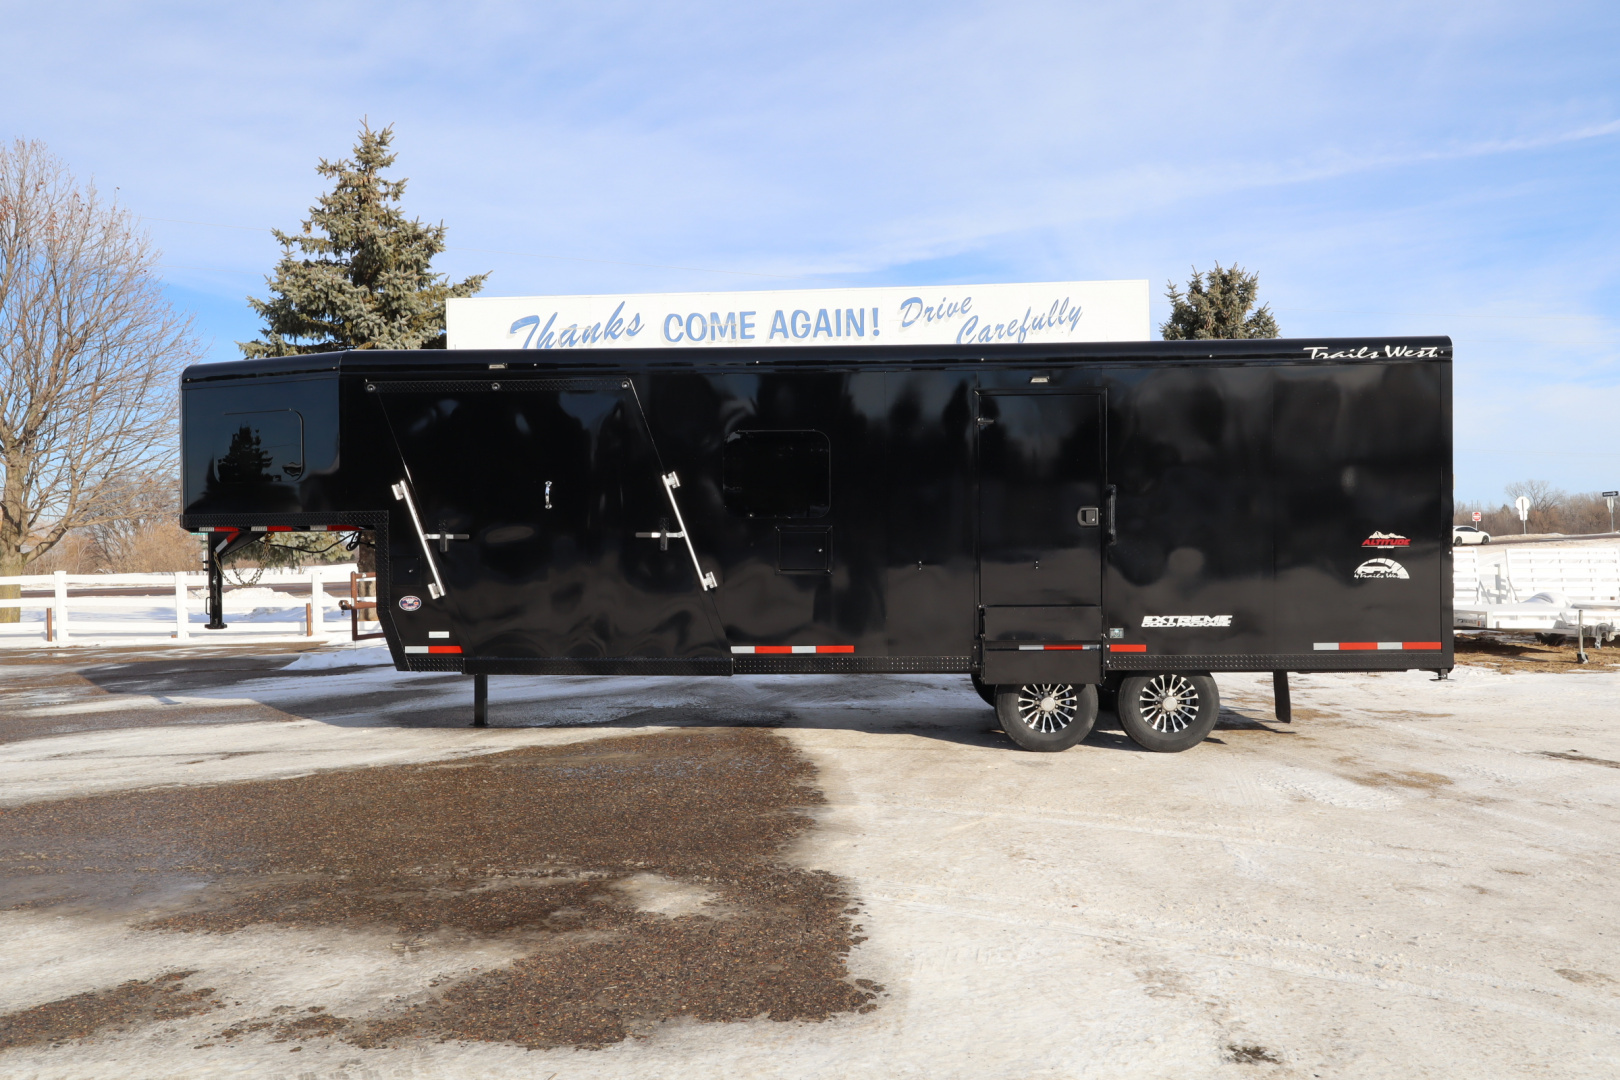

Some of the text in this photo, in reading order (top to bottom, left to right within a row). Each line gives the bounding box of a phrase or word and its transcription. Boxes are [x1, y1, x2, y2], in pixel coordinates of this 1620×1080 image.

[900, 296, 972, 328] Drive
[956, 297, 1083, 345] Carefully
[509, 301, 880, 349] Thanks COME AGAIN!
[1303, 345, 1438, 360] Trails West
[1361, 538, 1411, 546] ALTITUDE
[1142, 615, 1233, 624] EXTREME
